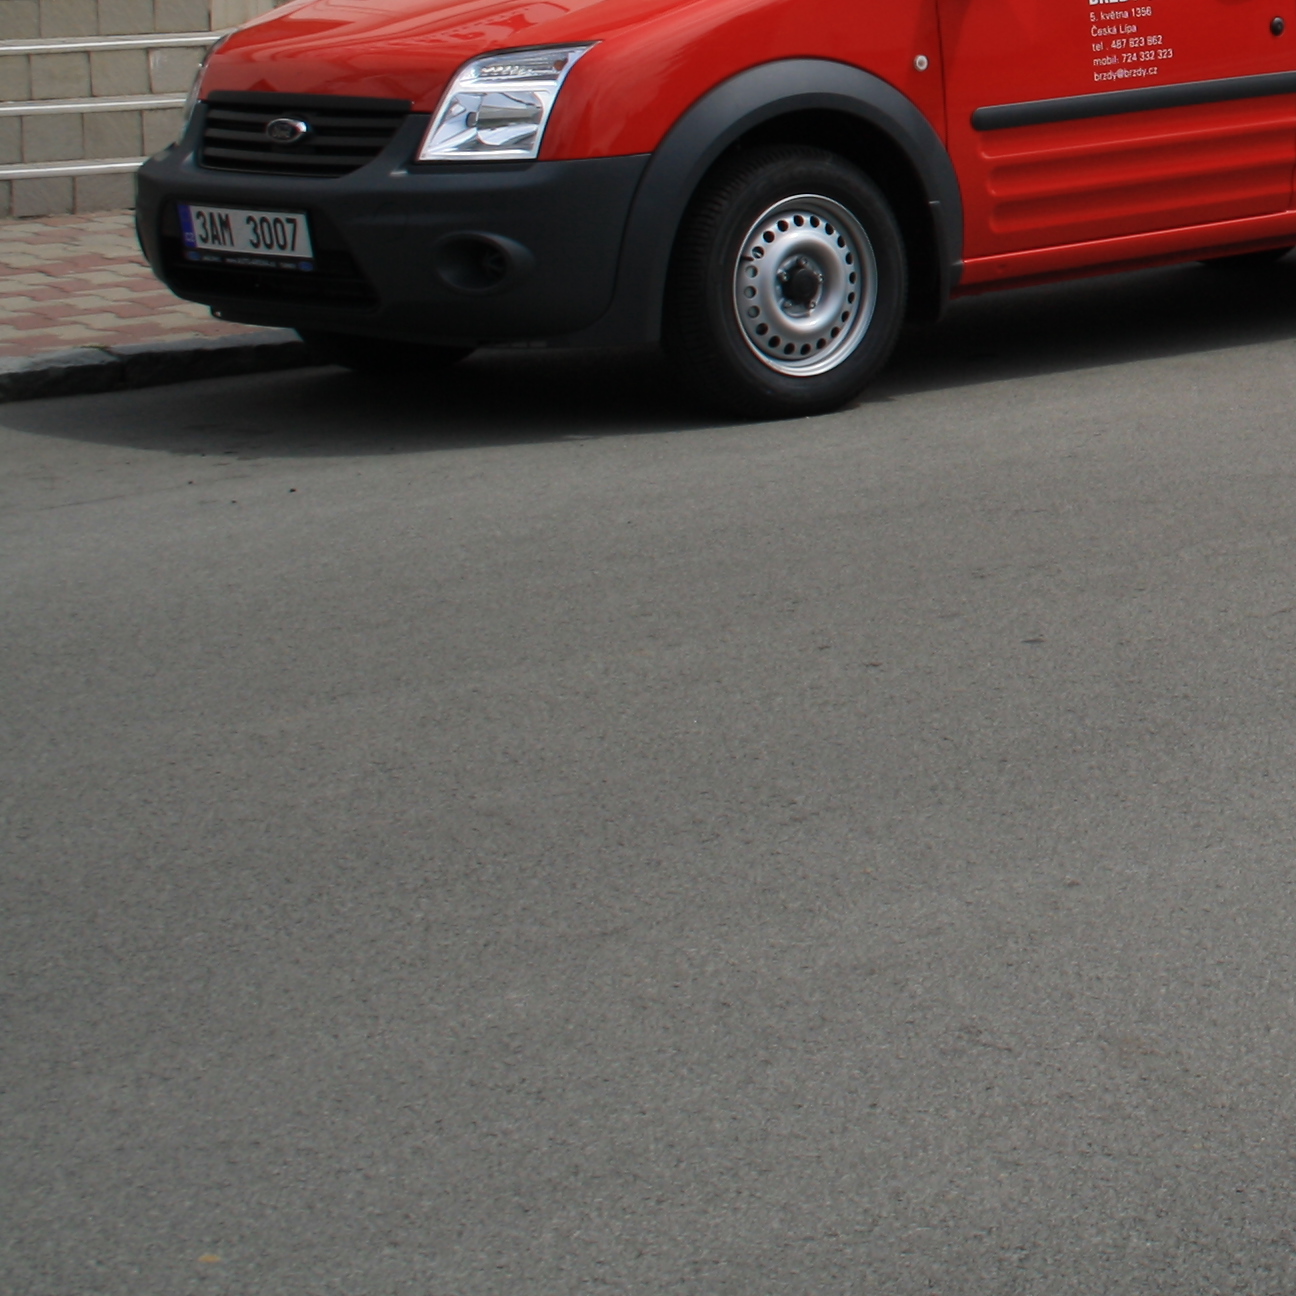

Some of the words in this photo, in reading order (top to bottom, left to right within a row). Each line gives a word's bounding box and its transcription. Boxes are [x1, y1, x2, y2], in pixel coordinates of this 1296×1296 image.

[1100, 10, 1129, 20] května
[1091, 24, 1117, 37] Česká
[1119, 23, 1137, 35] Lípa
[1121, 53, 1137, 63] 724
[1140, 51, 1155, 61] 332
[1157, 48, 1173, 59] 323
[1094, 67, 1158, 81] brzdy@brzdy.cz
[196, 211, 234, 246] 3AM
[246, 215, 297, 251] 3007
